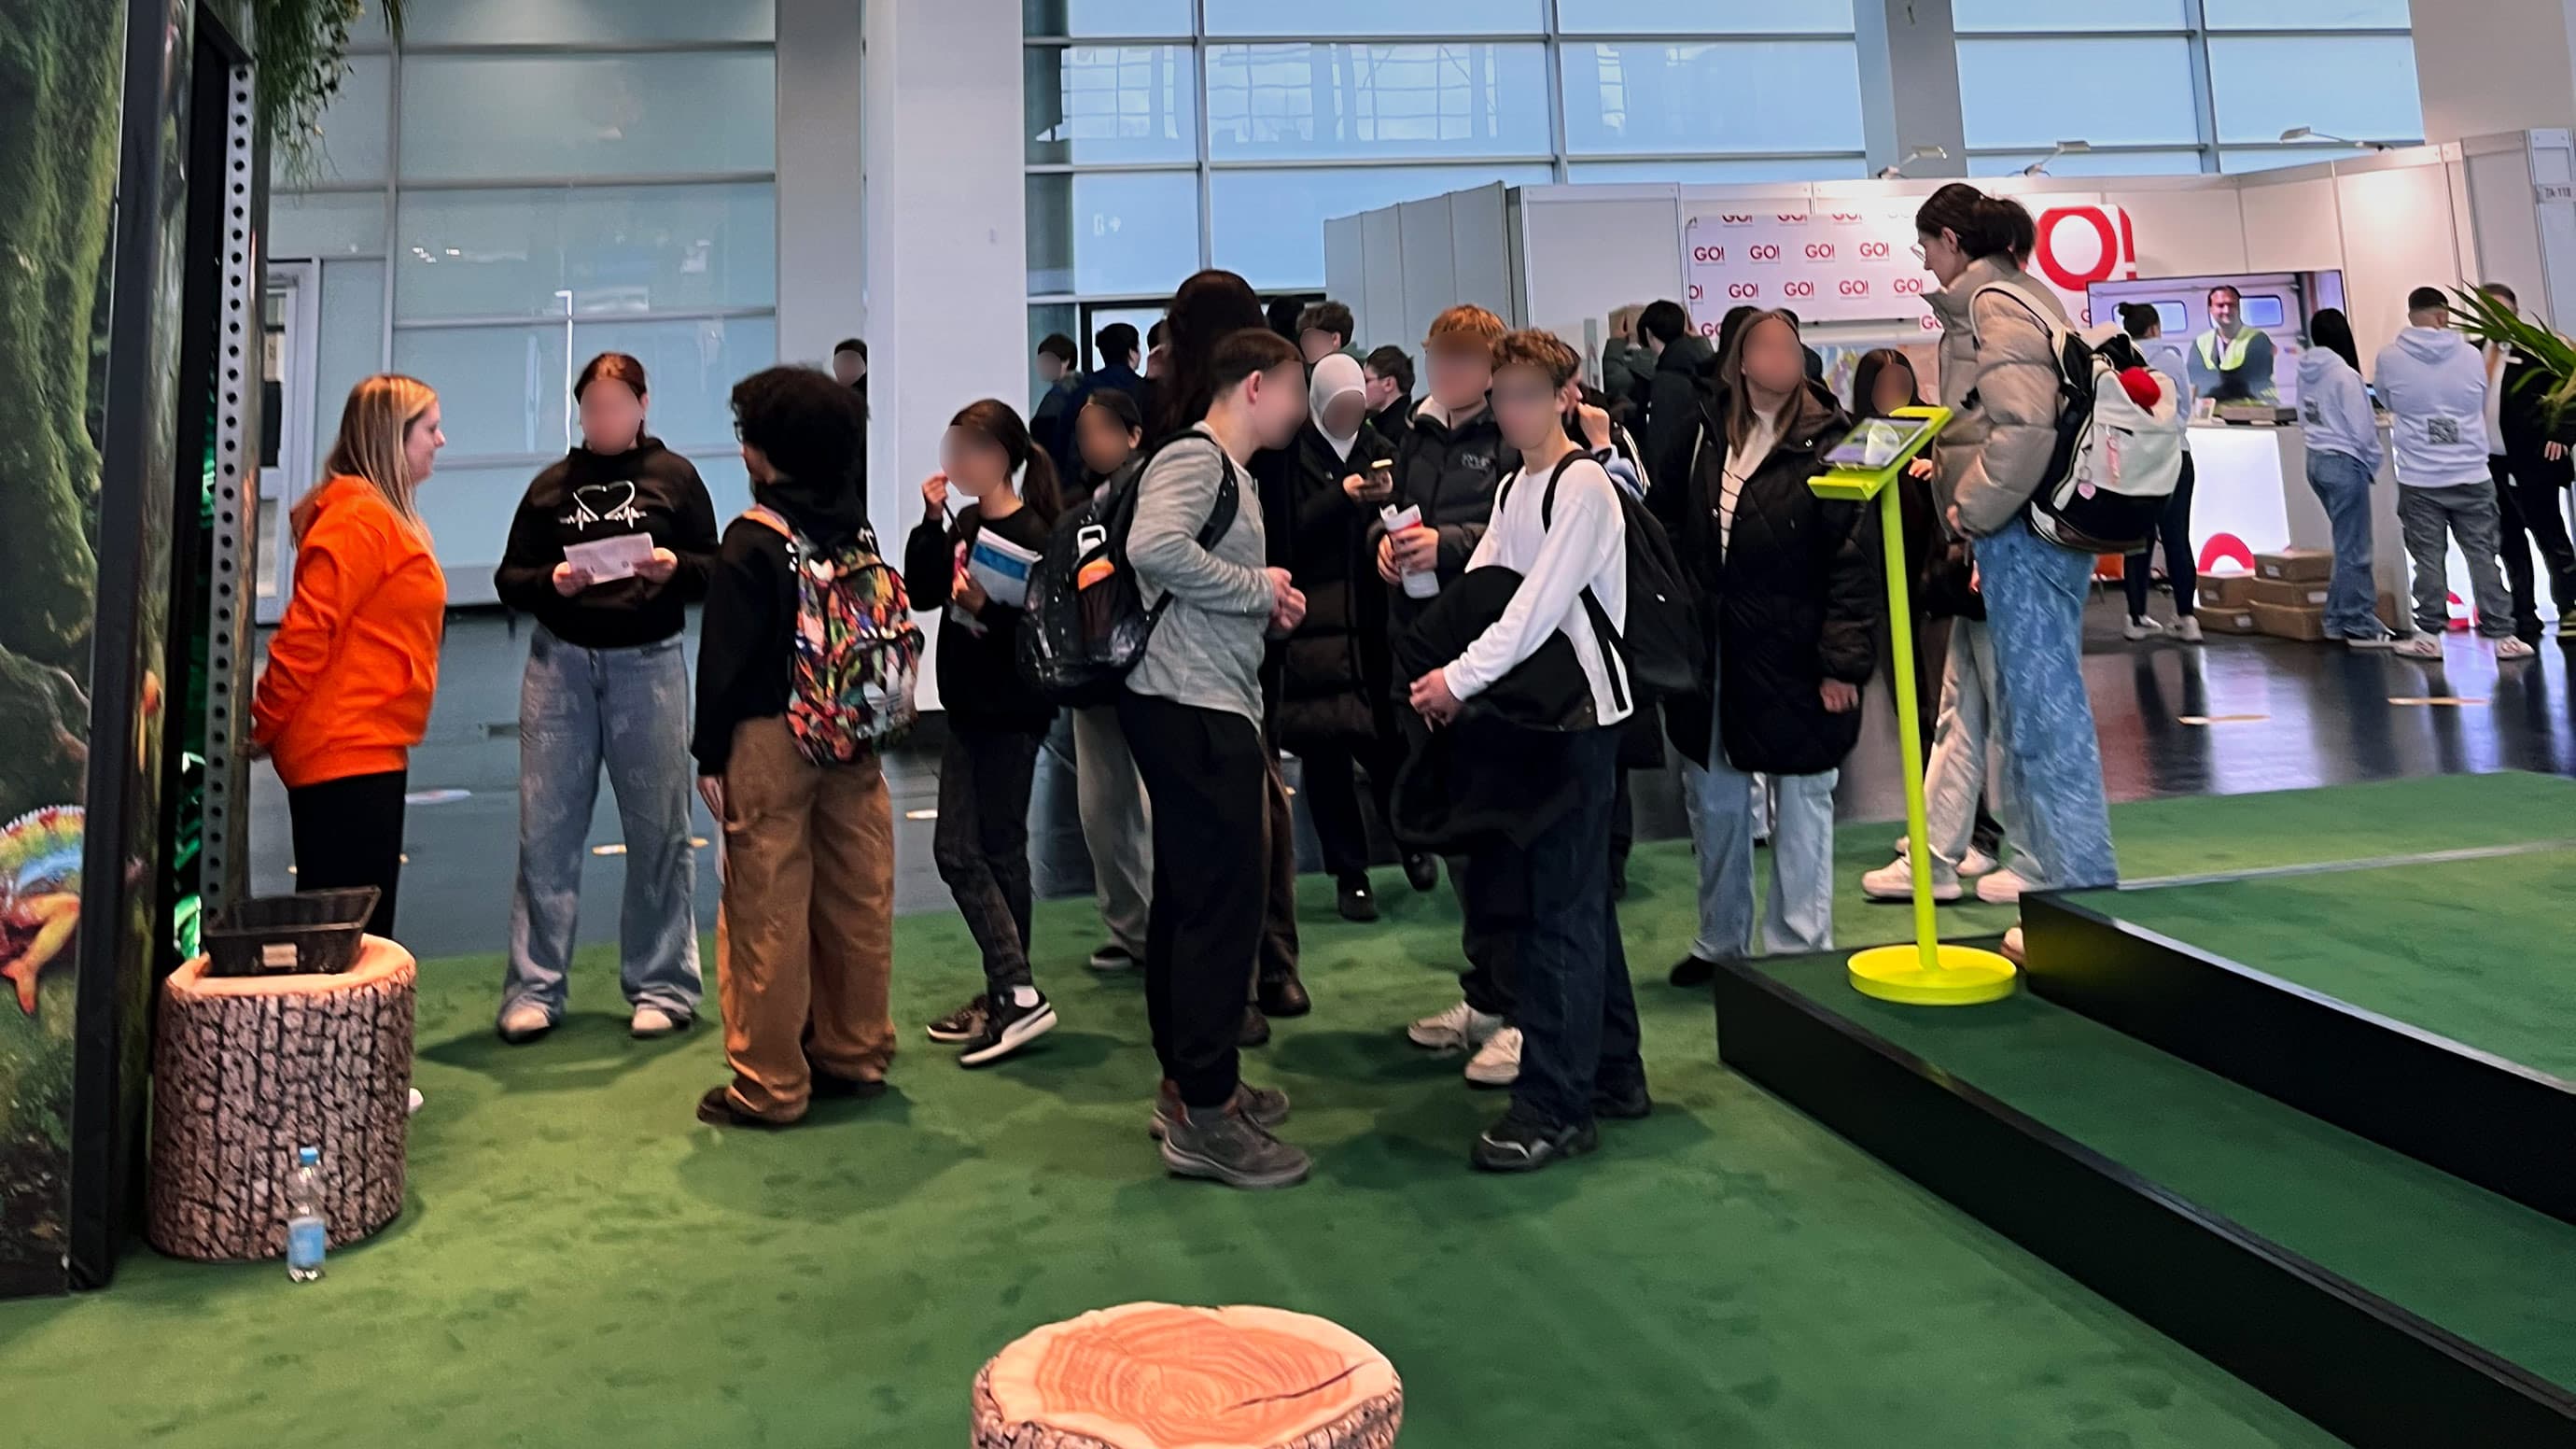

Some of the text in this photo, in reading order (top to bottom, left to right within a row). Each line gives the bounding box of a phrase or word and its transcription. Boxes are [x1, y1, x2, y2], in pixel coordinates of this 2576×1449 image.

[1694, 242, 1890, 261] GO! GO! GO! GO!
[2036, 205, 2137, 291] O!
[1688, 278, 1924, 300] O! GO! GO! GO! GO!
